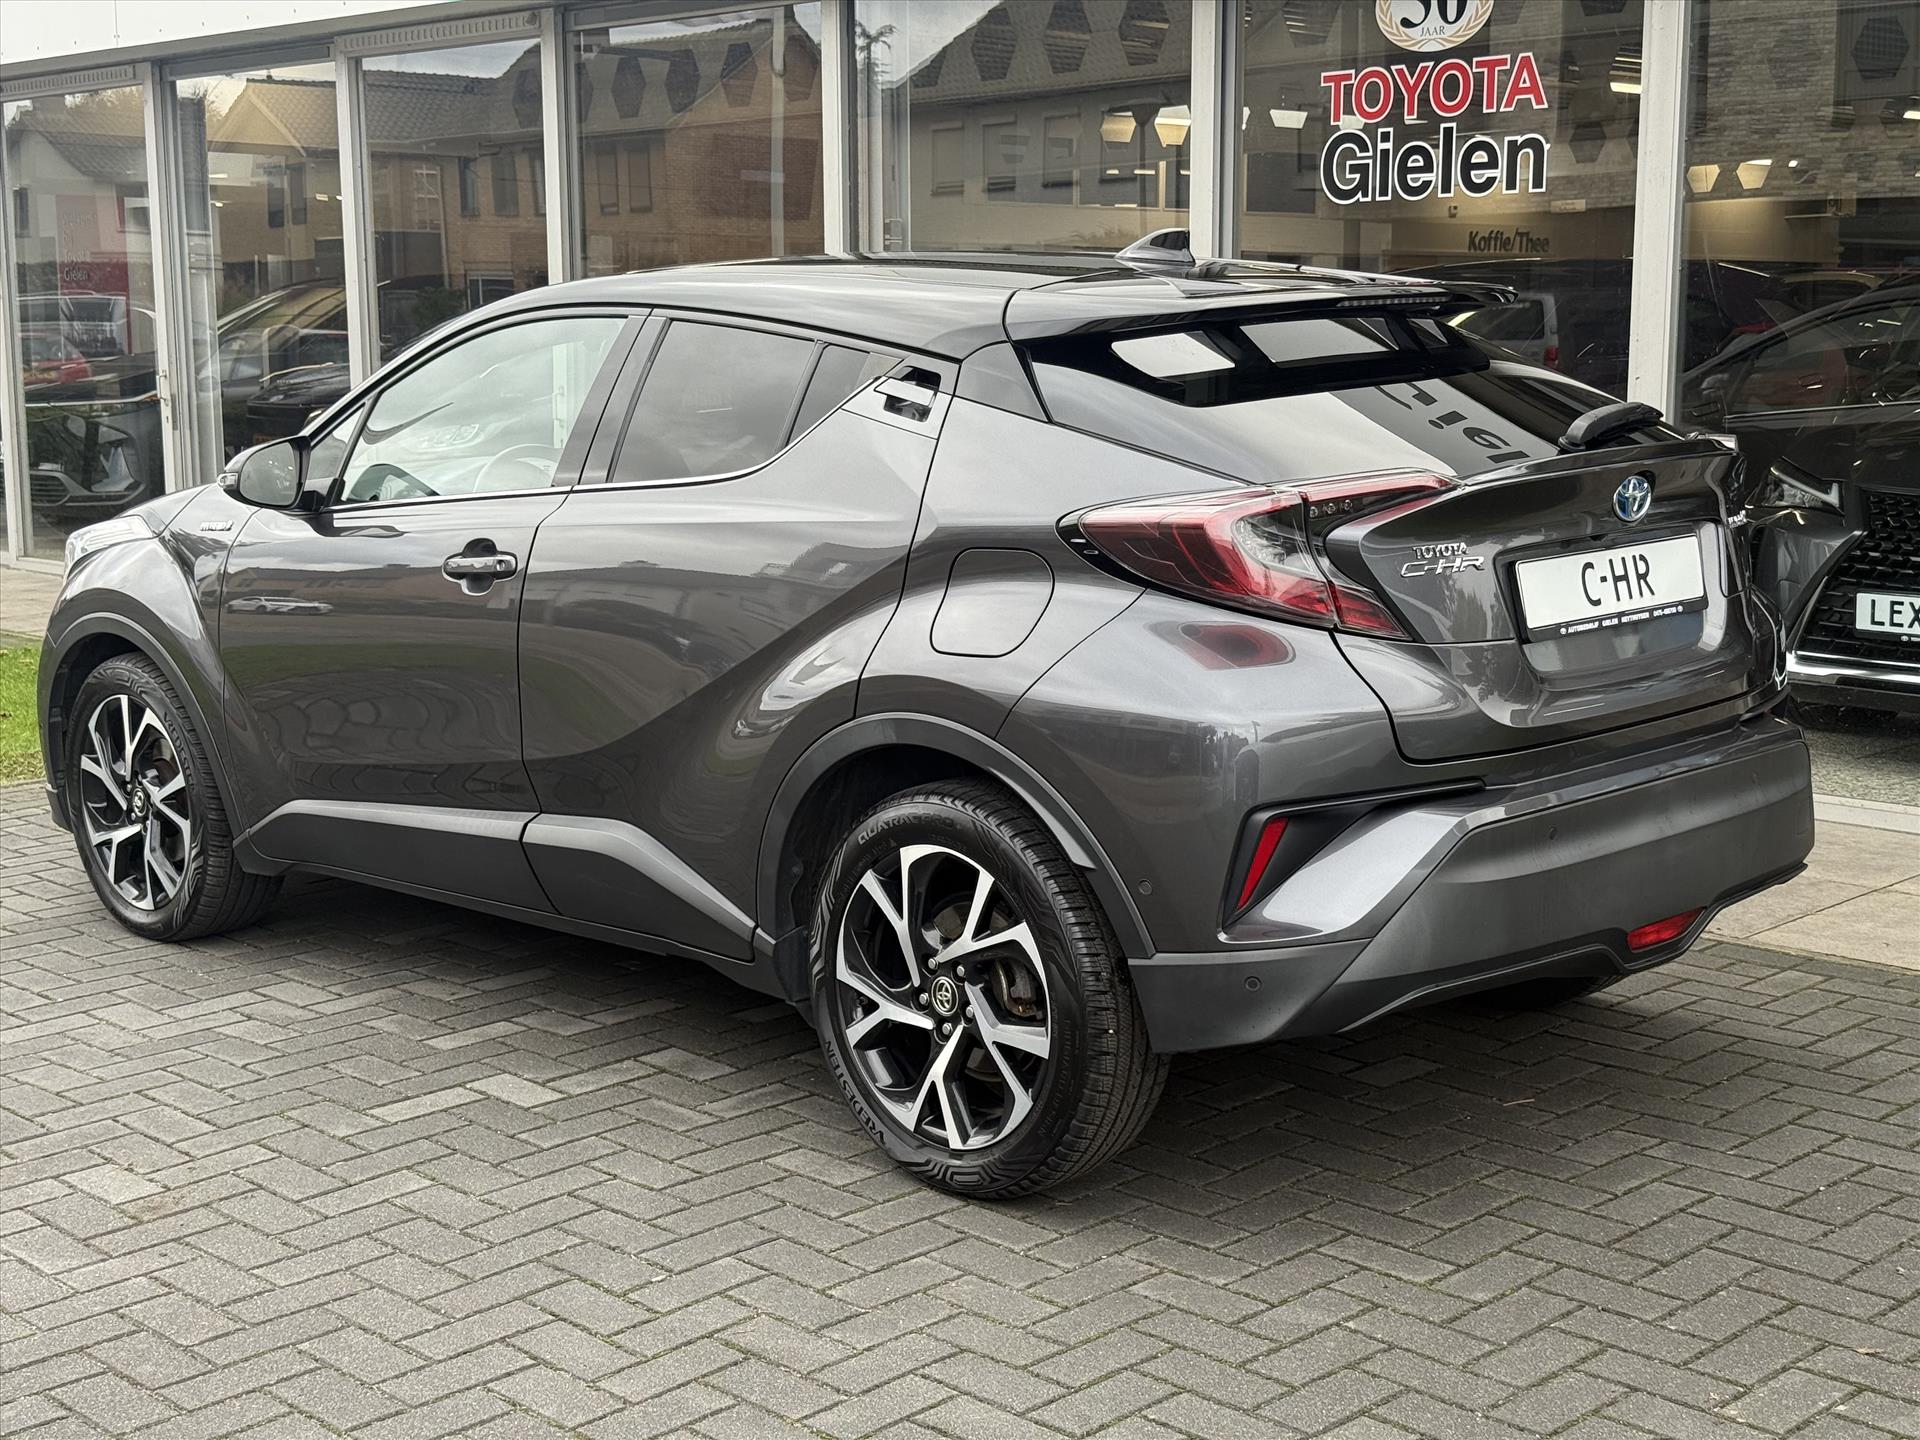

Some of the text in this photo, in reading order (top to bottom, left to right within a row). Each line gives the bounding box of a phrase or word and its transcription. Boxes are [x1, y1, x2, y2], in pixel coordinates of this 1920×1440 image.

[1419, 25, 1446, 37] JAAR
[1320, 52, 1549, 125] TOYOTA
[1320, 122, 1551, 205] Gielen
[1400, 555, 1486, 578] C-HR
[1413, 542, 1470, 560] TOYOTA
[1580, 553, 1656, 607] C-HR
[824, 1040, 887, 1146] VREDESTEIN
